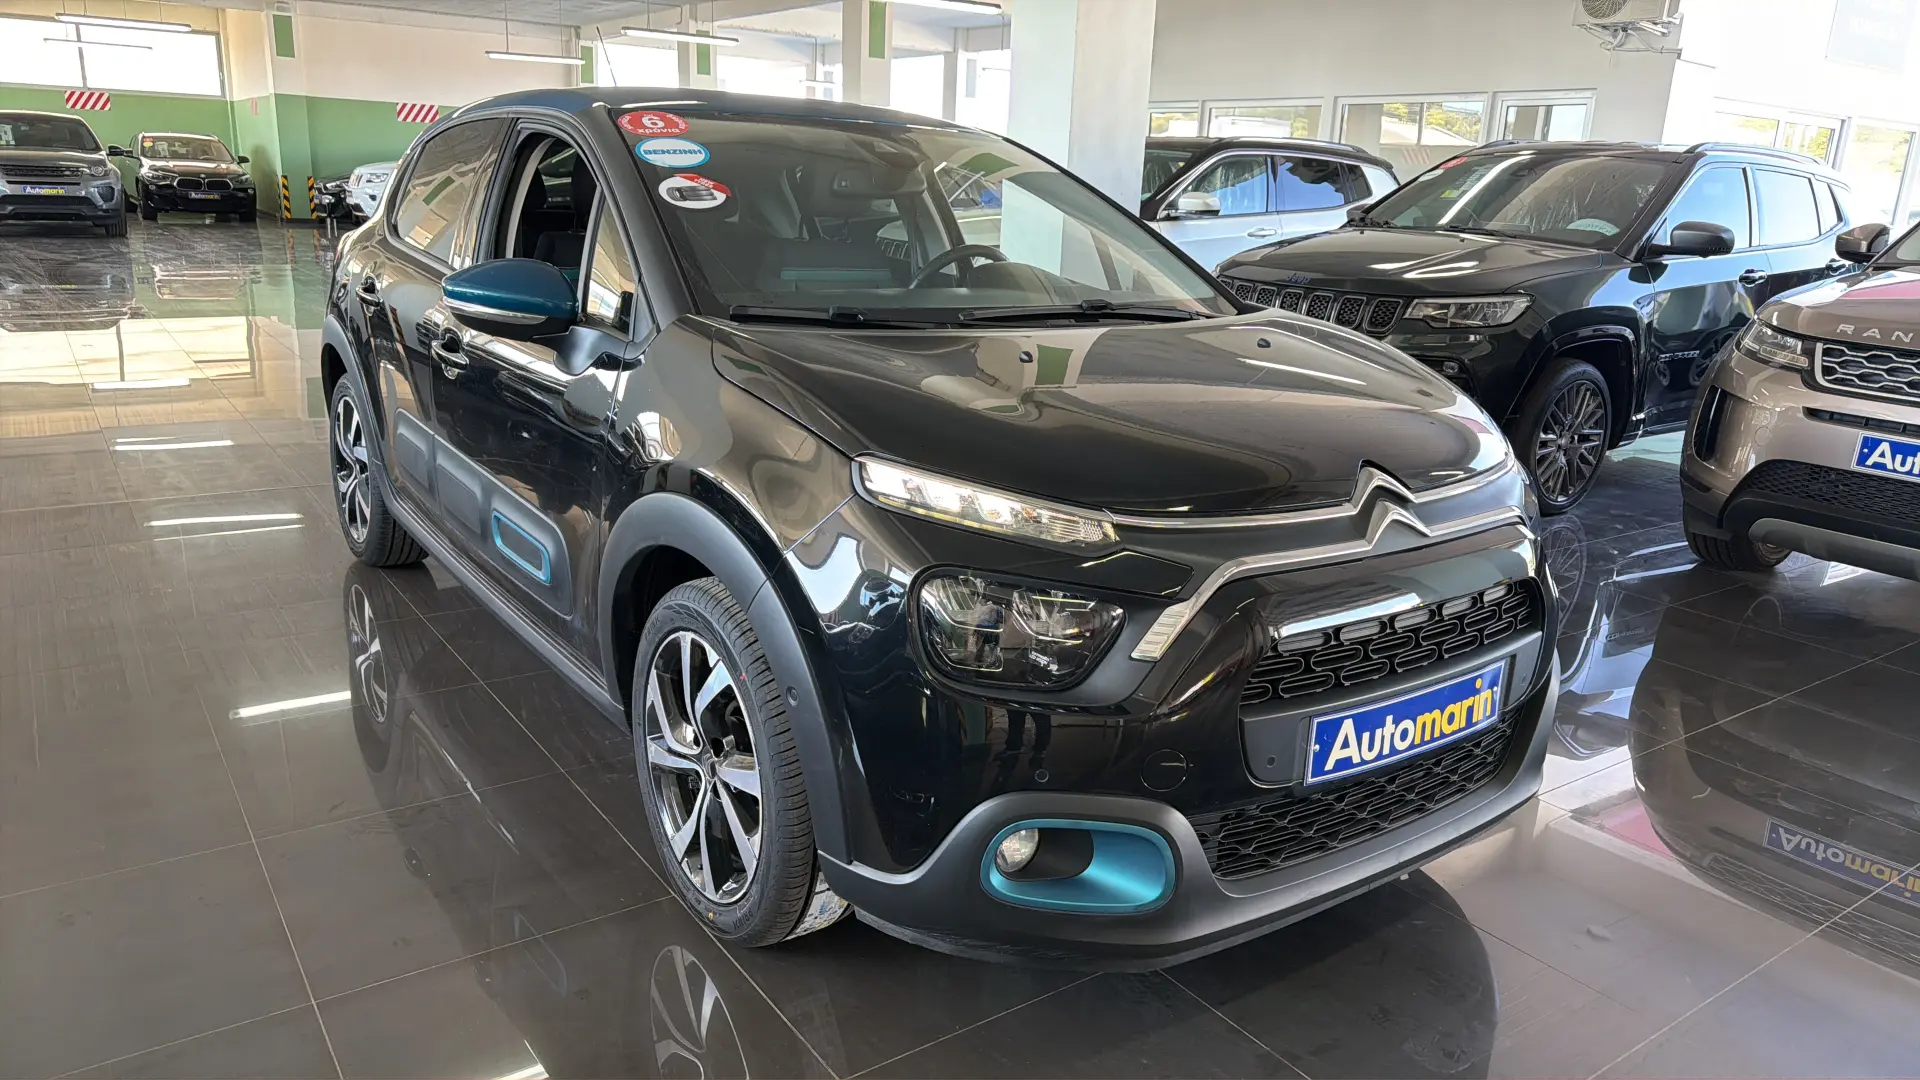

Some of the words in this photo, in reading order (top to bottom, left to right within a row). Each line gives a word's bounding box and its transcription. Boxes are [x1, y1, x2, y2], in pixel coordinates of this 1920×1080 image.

[641, 116, 665, 128] 6
[25, 186, 65, 194] Automarin
[1286, 273, 1310, 284] Jeep
[1836, 323, 1915, 343] RAN
[1324, 678, 1493, 771] Automarin
